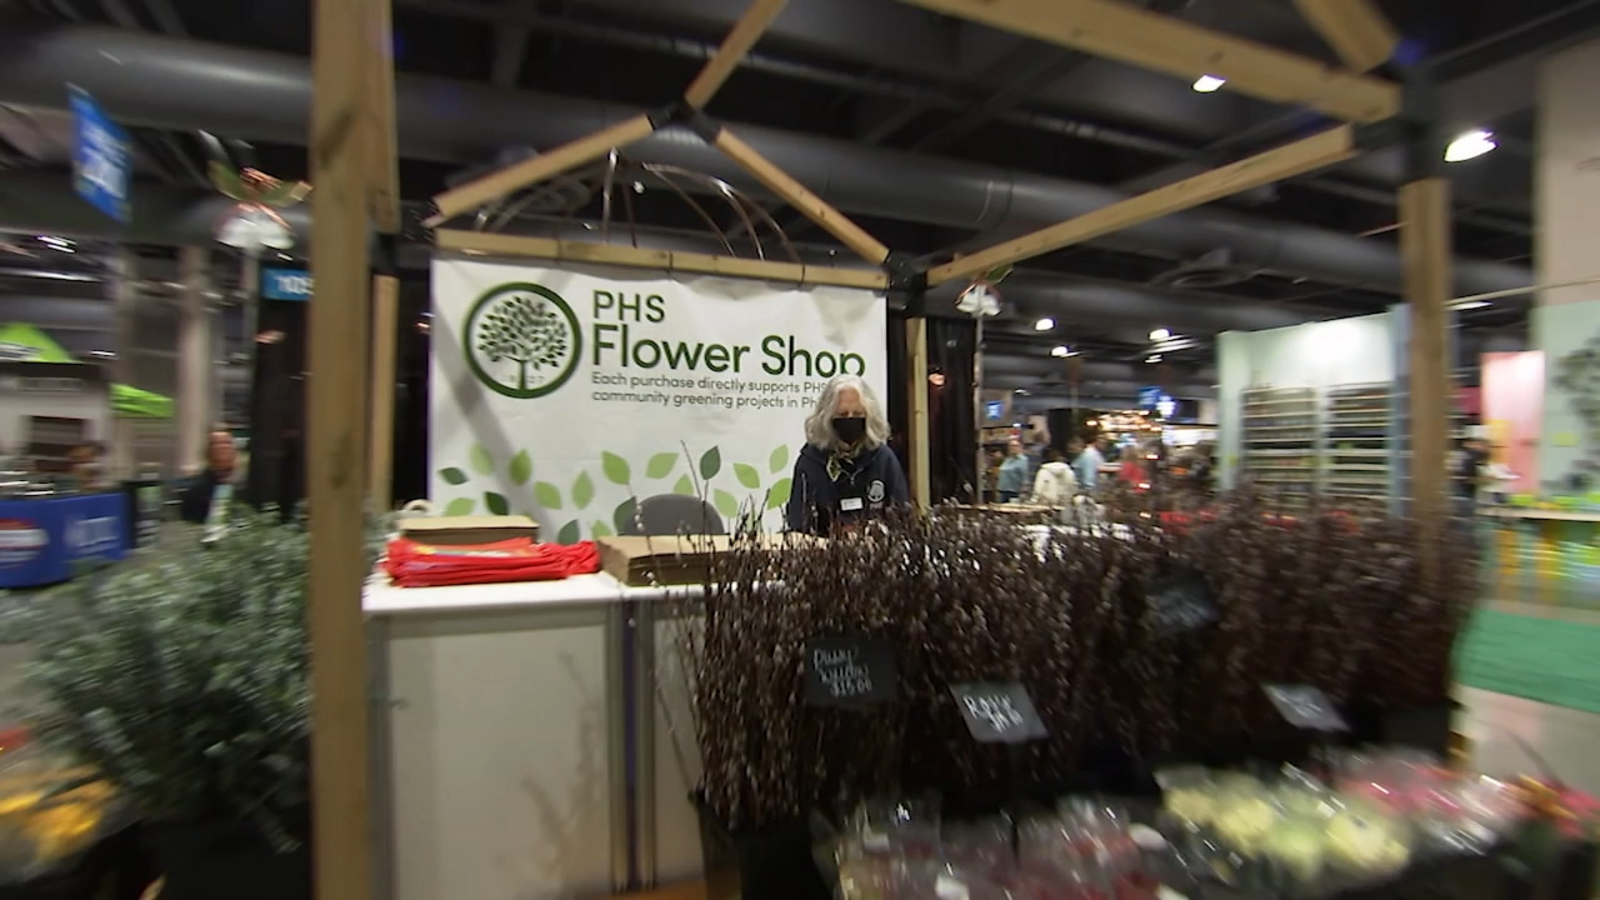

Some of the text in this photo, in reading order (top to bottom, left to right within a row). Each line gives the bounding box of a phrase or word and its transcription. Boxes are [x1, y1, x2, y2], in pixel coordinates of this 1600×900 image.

[593, 290, 666, 323] PHS
[593, 323, 866, 379] Flower Shop
[591, 371, 627, 385] Each
[629, 374, 695, 389] purchase
[697, 377, 746, 393] directly
[748, 381, 800, 395] supports
[591, 390, 670, 407] community
[672, 393, 734, 409] greening
[735, 395, 785, 410] projects
[787, 397, 799, 408] in
